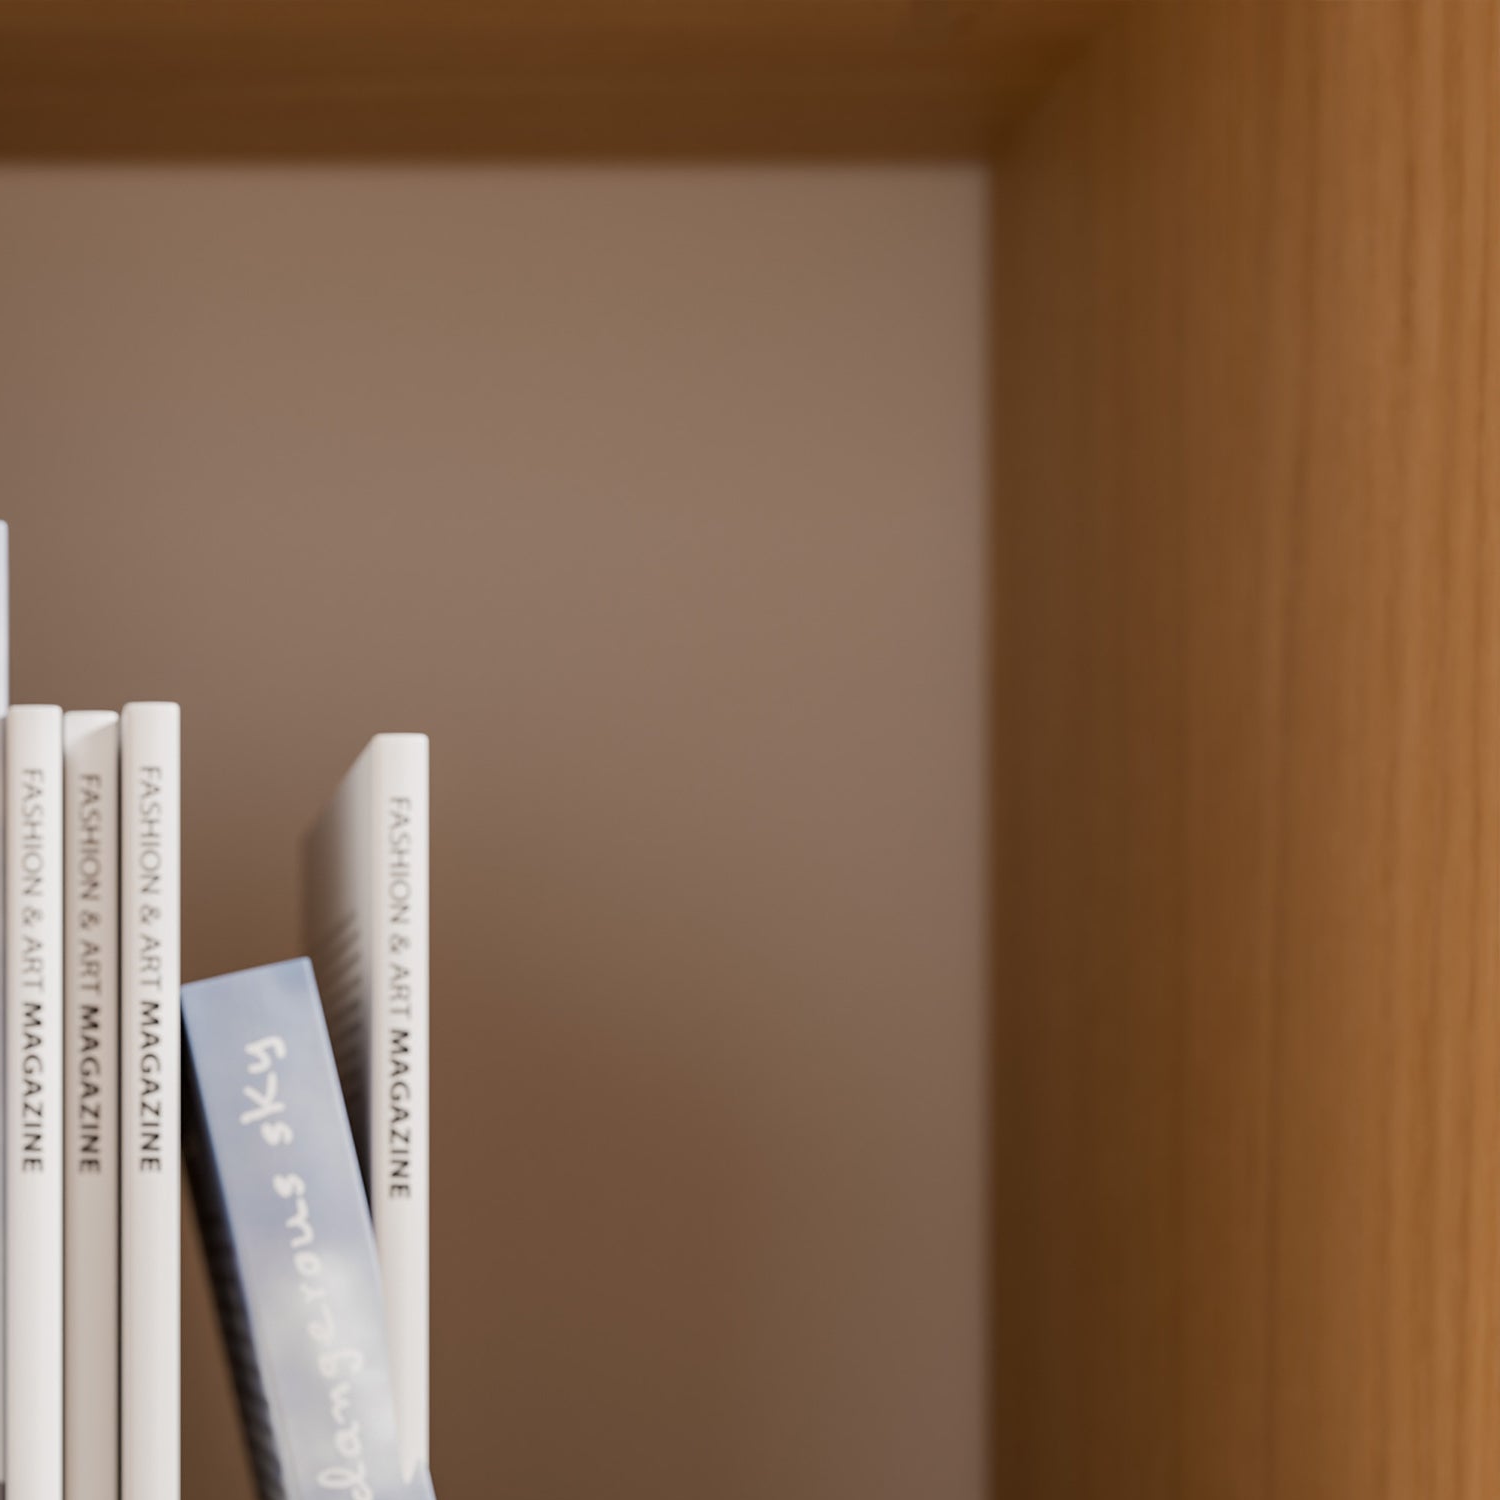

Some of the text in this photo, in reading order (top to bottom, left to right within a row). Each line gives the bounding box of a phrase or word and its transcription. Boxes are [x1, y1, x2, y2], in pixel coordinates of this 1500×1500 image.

[22, 767, 44, 1173] FASHION & ART MAGAZINE
[79, 772, 101, 1174] FASHION & ART MAGAZINE
[139, 766, 161, 1173] FASHION & ART MAGAZINE
[239, 1034, 294, 1147] sky
[389, 796, 412, 1200] FASHION & ART MAGAZINE
